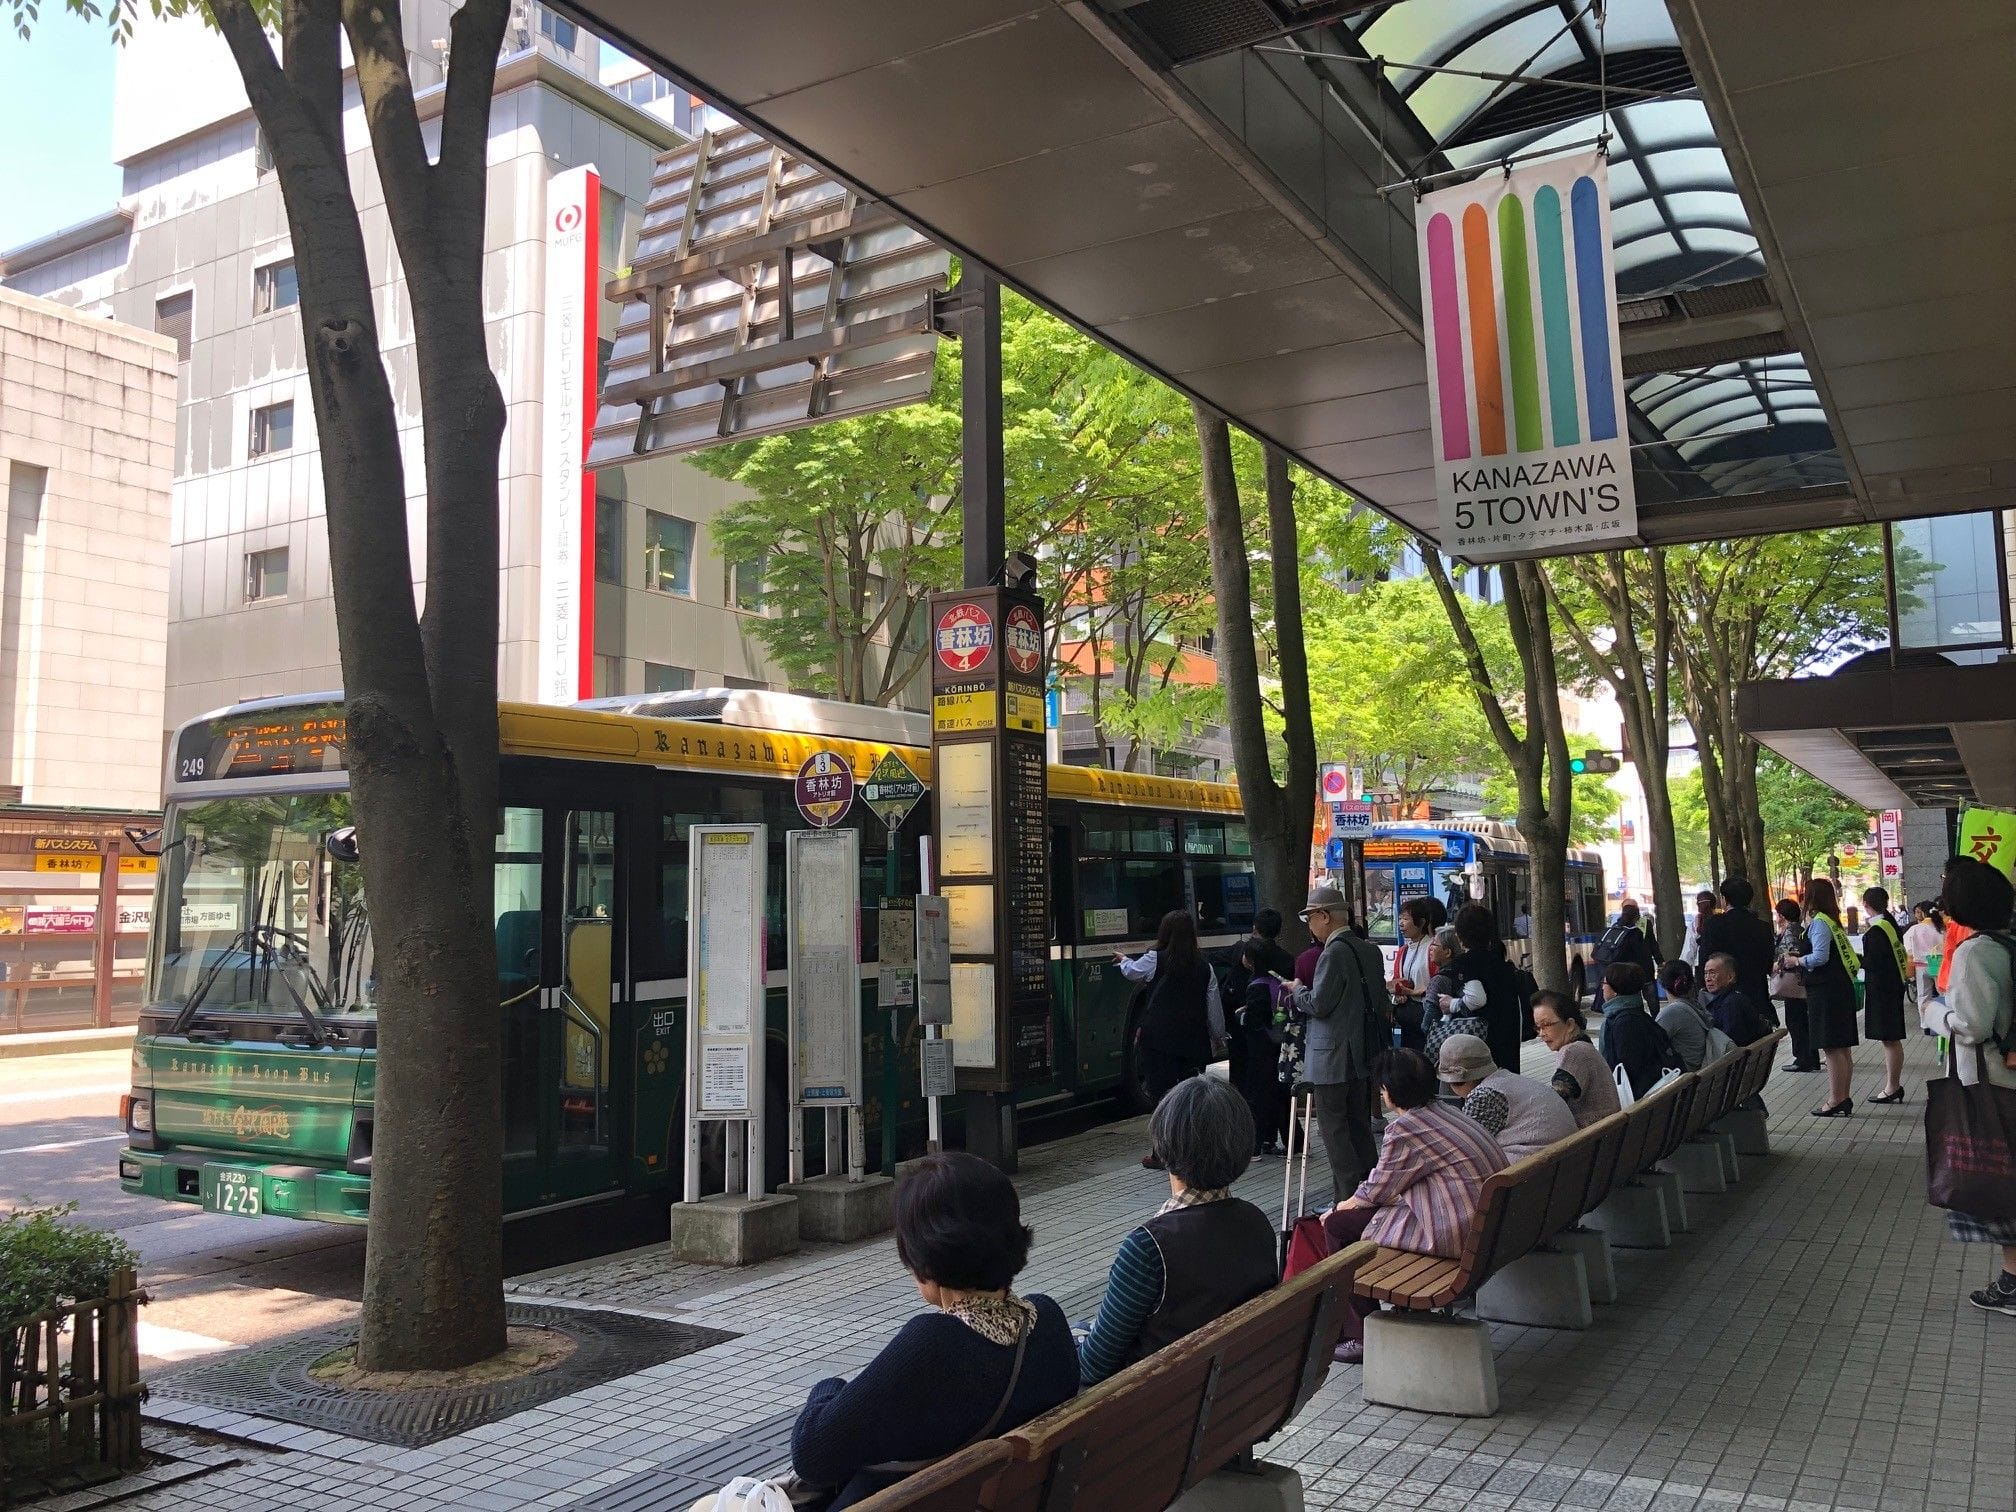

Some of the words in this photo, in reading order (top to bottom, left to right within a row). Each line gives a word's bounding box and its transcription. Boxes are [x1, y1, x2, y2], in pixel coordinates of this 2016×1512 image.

[554, 233, 582, 248] MUFG
[1453, 453, 1616, 493] KANAZAWA
[948, 607, 981, 623] 北鉄バス
[554, 580, 569, 704] 三菱UFJ銀
[939, 626, 991, 649] 香林坊
[1007, 627, 1040, 651] 香林坊
[958, 656, 970, 670] 4
[1020, 658, 1028, 671] 4
[937, 695, 973, 707] 路線バス
[937, 718, 973, 730] 高速バス
[655, 730, 789, 763] Kanazawa
[182, 757, 204, 777] 249
[820, 762, 826, 772] 3
[805, 775, 842, 792] 香林坊
[1335, 814, 1369, 826] 香林坊
[34, 838, 98, 850] 新バスシステム
[1882, 812, 1898, 876] 岡三証券
[47, 858, 82, 869] 香林坊
[200, 911, 232, 921] 方面ゆき
[653, 1011, 674, 1027] 出口
[656, 1026, 671, 1036] EXIT
[248, 1064, 289, 1083] Loop
[298, 1067, 331, 1083] Bus
[216, 1183, 259, 1214] 12-25
